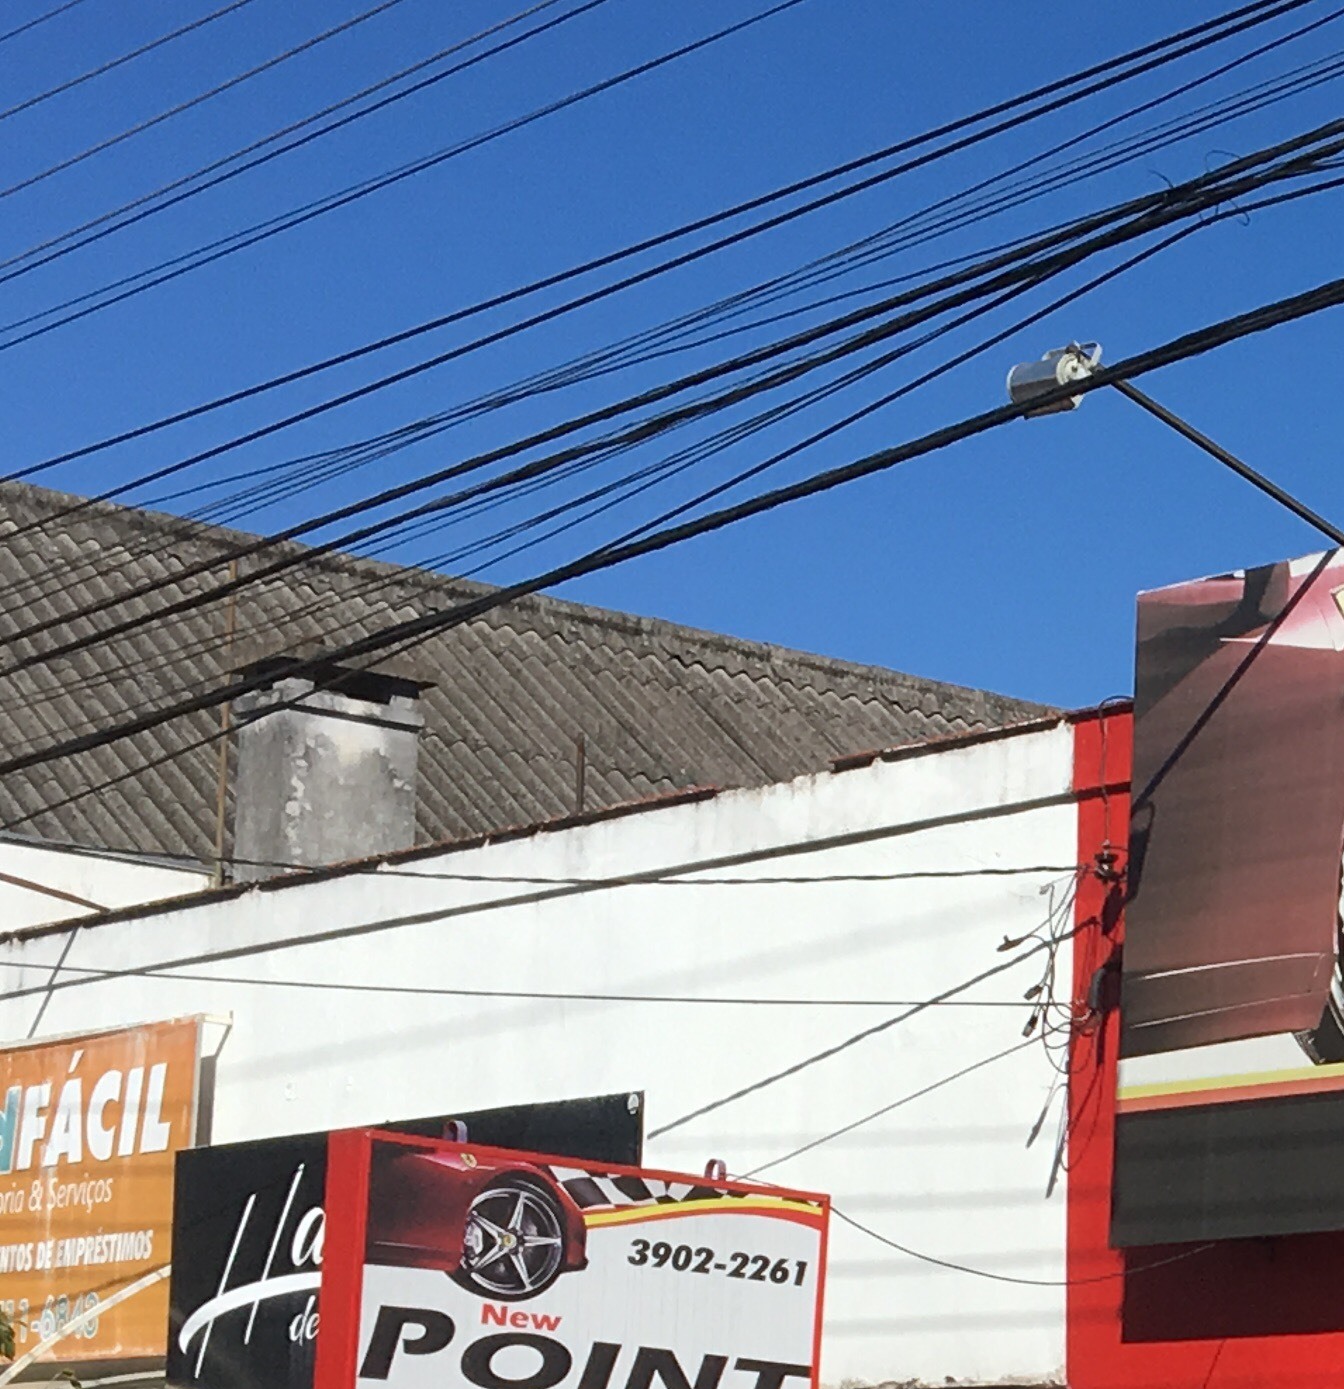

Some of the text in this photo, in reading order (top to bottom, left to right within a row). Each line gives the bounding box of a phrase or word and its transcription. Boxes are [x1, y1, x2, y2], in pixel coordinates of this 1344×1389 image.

[47, 1172, 114, 1214] Serviços
[627, 1238, 808, 1287] 3902-2261
[480, 1303, 562, 1332] New
